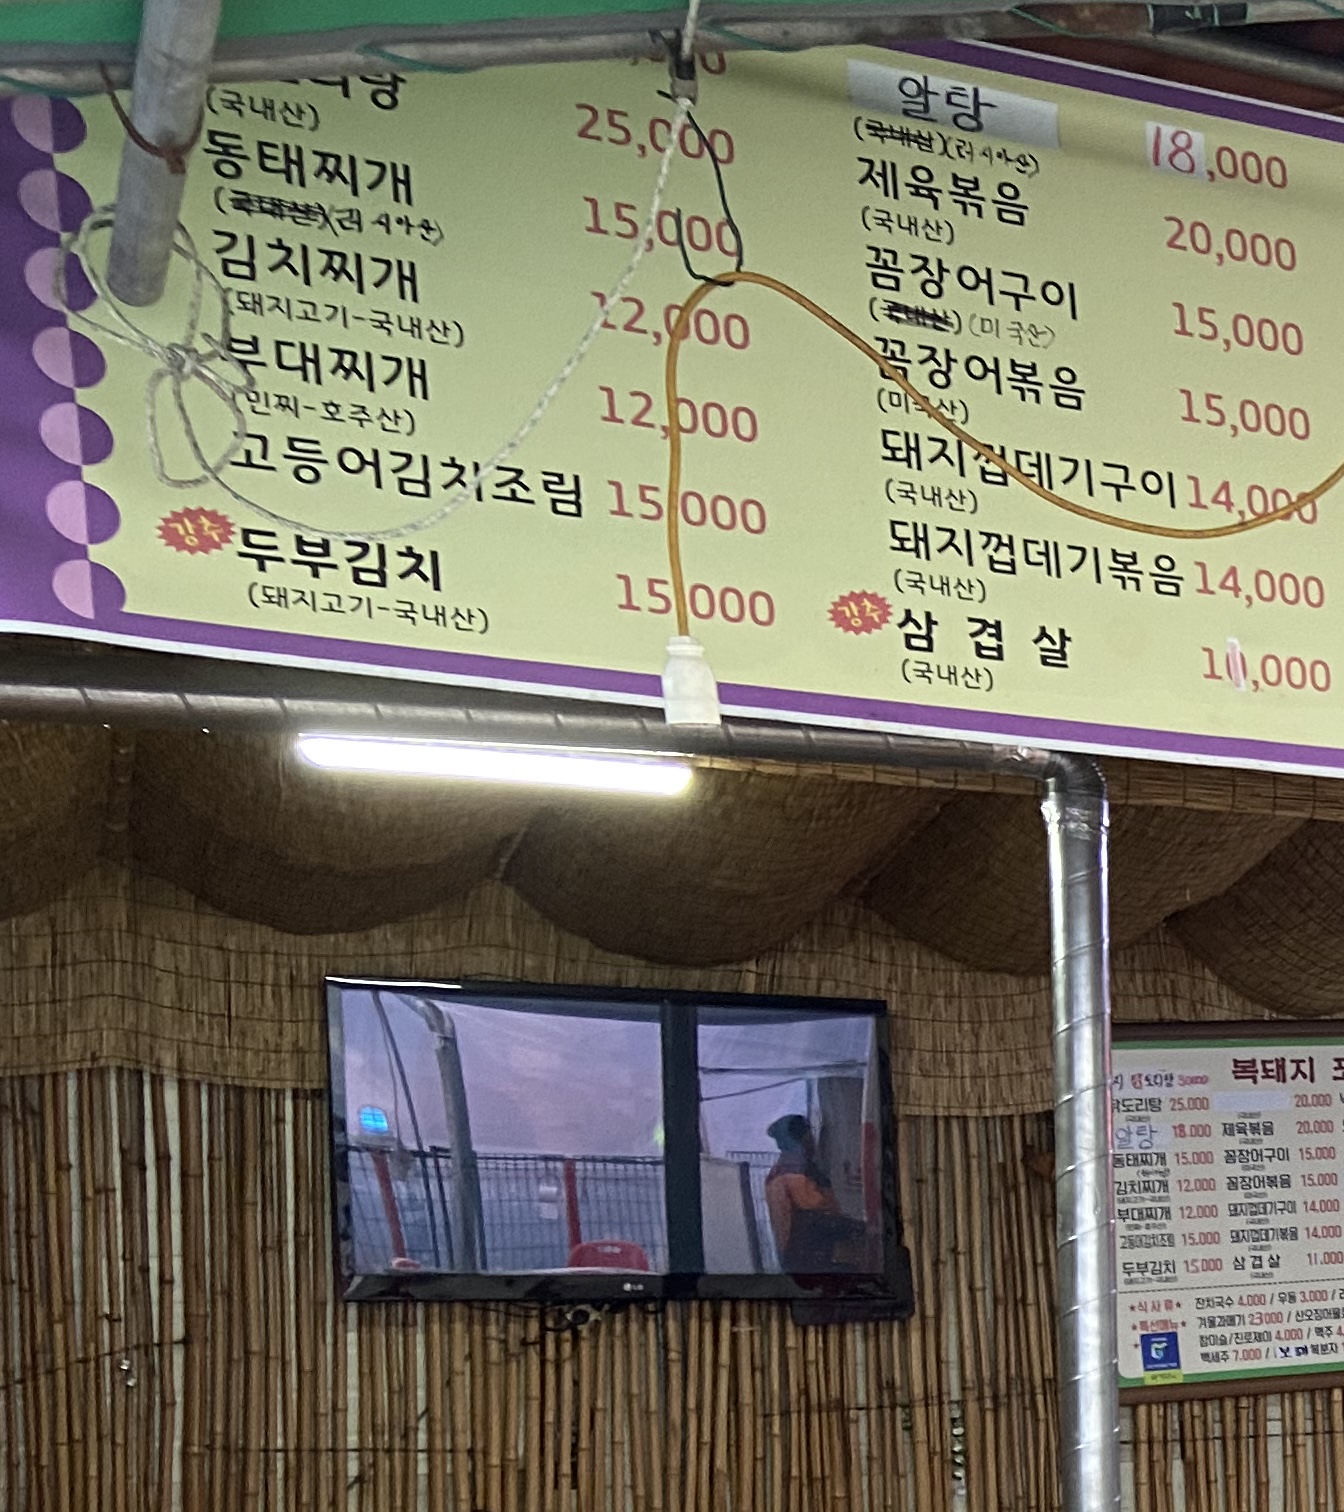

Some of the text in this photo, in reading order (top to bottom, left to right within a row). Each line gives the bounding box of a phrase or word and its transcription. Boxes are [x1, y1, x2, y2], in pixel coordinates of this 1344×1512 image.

[206, 85, 321, 131] (국내산)
[575, 102, 735, 165] 25,000
[898, 75, 998, 134] 알탕
[1150, 126, 1289, 189] 18,000
[202, 128, 740, 258] 동태찌개 15,000
[856, 155, 1298, 272] 제육볶음 20,000
[860, 205, 956, 247] (국내산)
[212, 228, 750, 350] 김치찌개 12,000
[863, 244, 1080, 322] 꼼장어구이
[1171, 302, 1305, 357] 15,000
[229, 335, 758, 443] 부대찌개 12,000
[874, 336, 1313, 443] 꼼장어볶음 15,000
[231, 430, 584, 519] 고등어김치조림
[880, 426, 1320, 527] 돼지껍데기구이 14,000
[884, 478, 980, 516] (국내산)
[238, 527, 442, 592] 두부김치
[888, 518, 1326, 611] 돼지껍데기볶음 14,000
[892, 568, 988, 605] (국내산)
[248, 581, 489, 635] (돼지고기-국내산)
[900, 659, 996, 694] (국내산)
[1231, 1056, 1315, 1085] 복돼지
[1122, 1259, 1176, 1276] 두부김치
